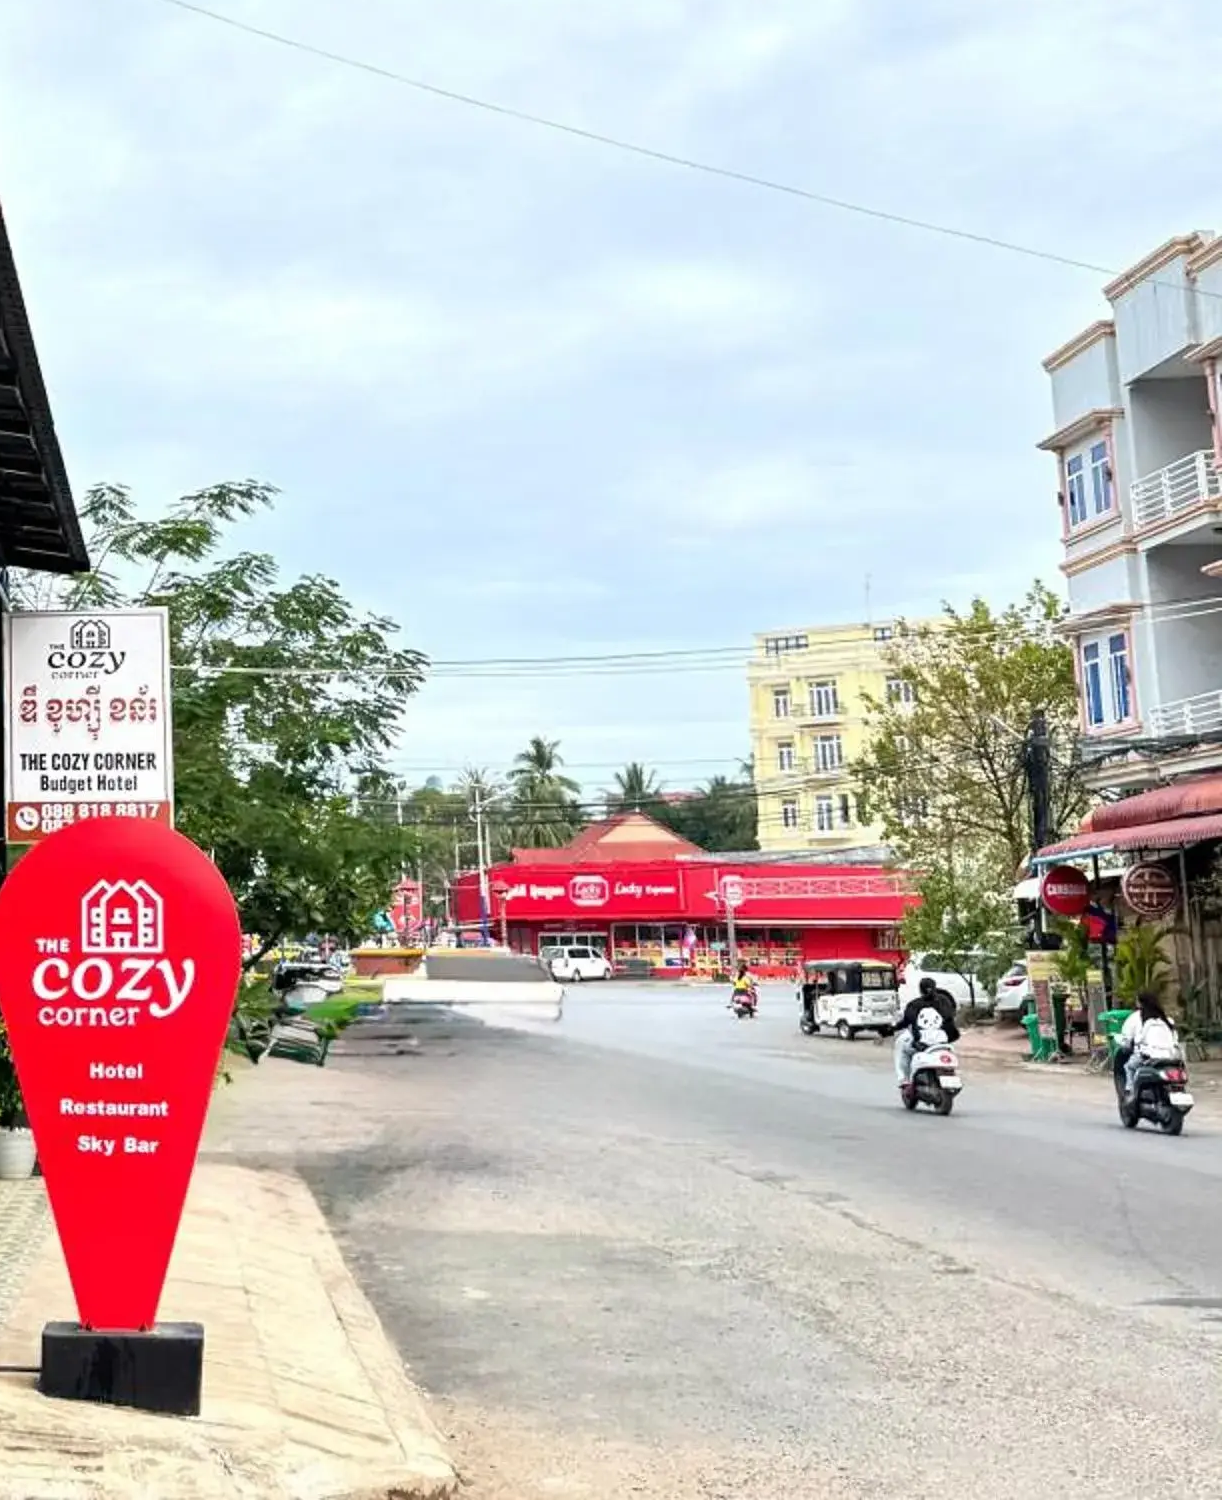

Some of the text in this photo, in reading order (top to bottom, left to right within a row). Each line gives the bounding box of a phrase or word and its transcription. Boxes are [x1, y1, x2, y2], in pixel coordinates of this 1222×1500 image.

[49, 643, 65, 651] THE
[51, 671, 98, 679] corner
[19, 752, 157, 771] THE COZY CORNER
[40, 774, 138, 795] Budget Hotel
[78, 803, 111, 818] 818
[35, 937, 71, 953] THE
[38, 1005, 140, 1028] corner
[89, 1061, 144, 1080] Hotel
[59, 1097, 169, 1117] Restaurant
[77, 1134, 159, 1157] Sky Bar
